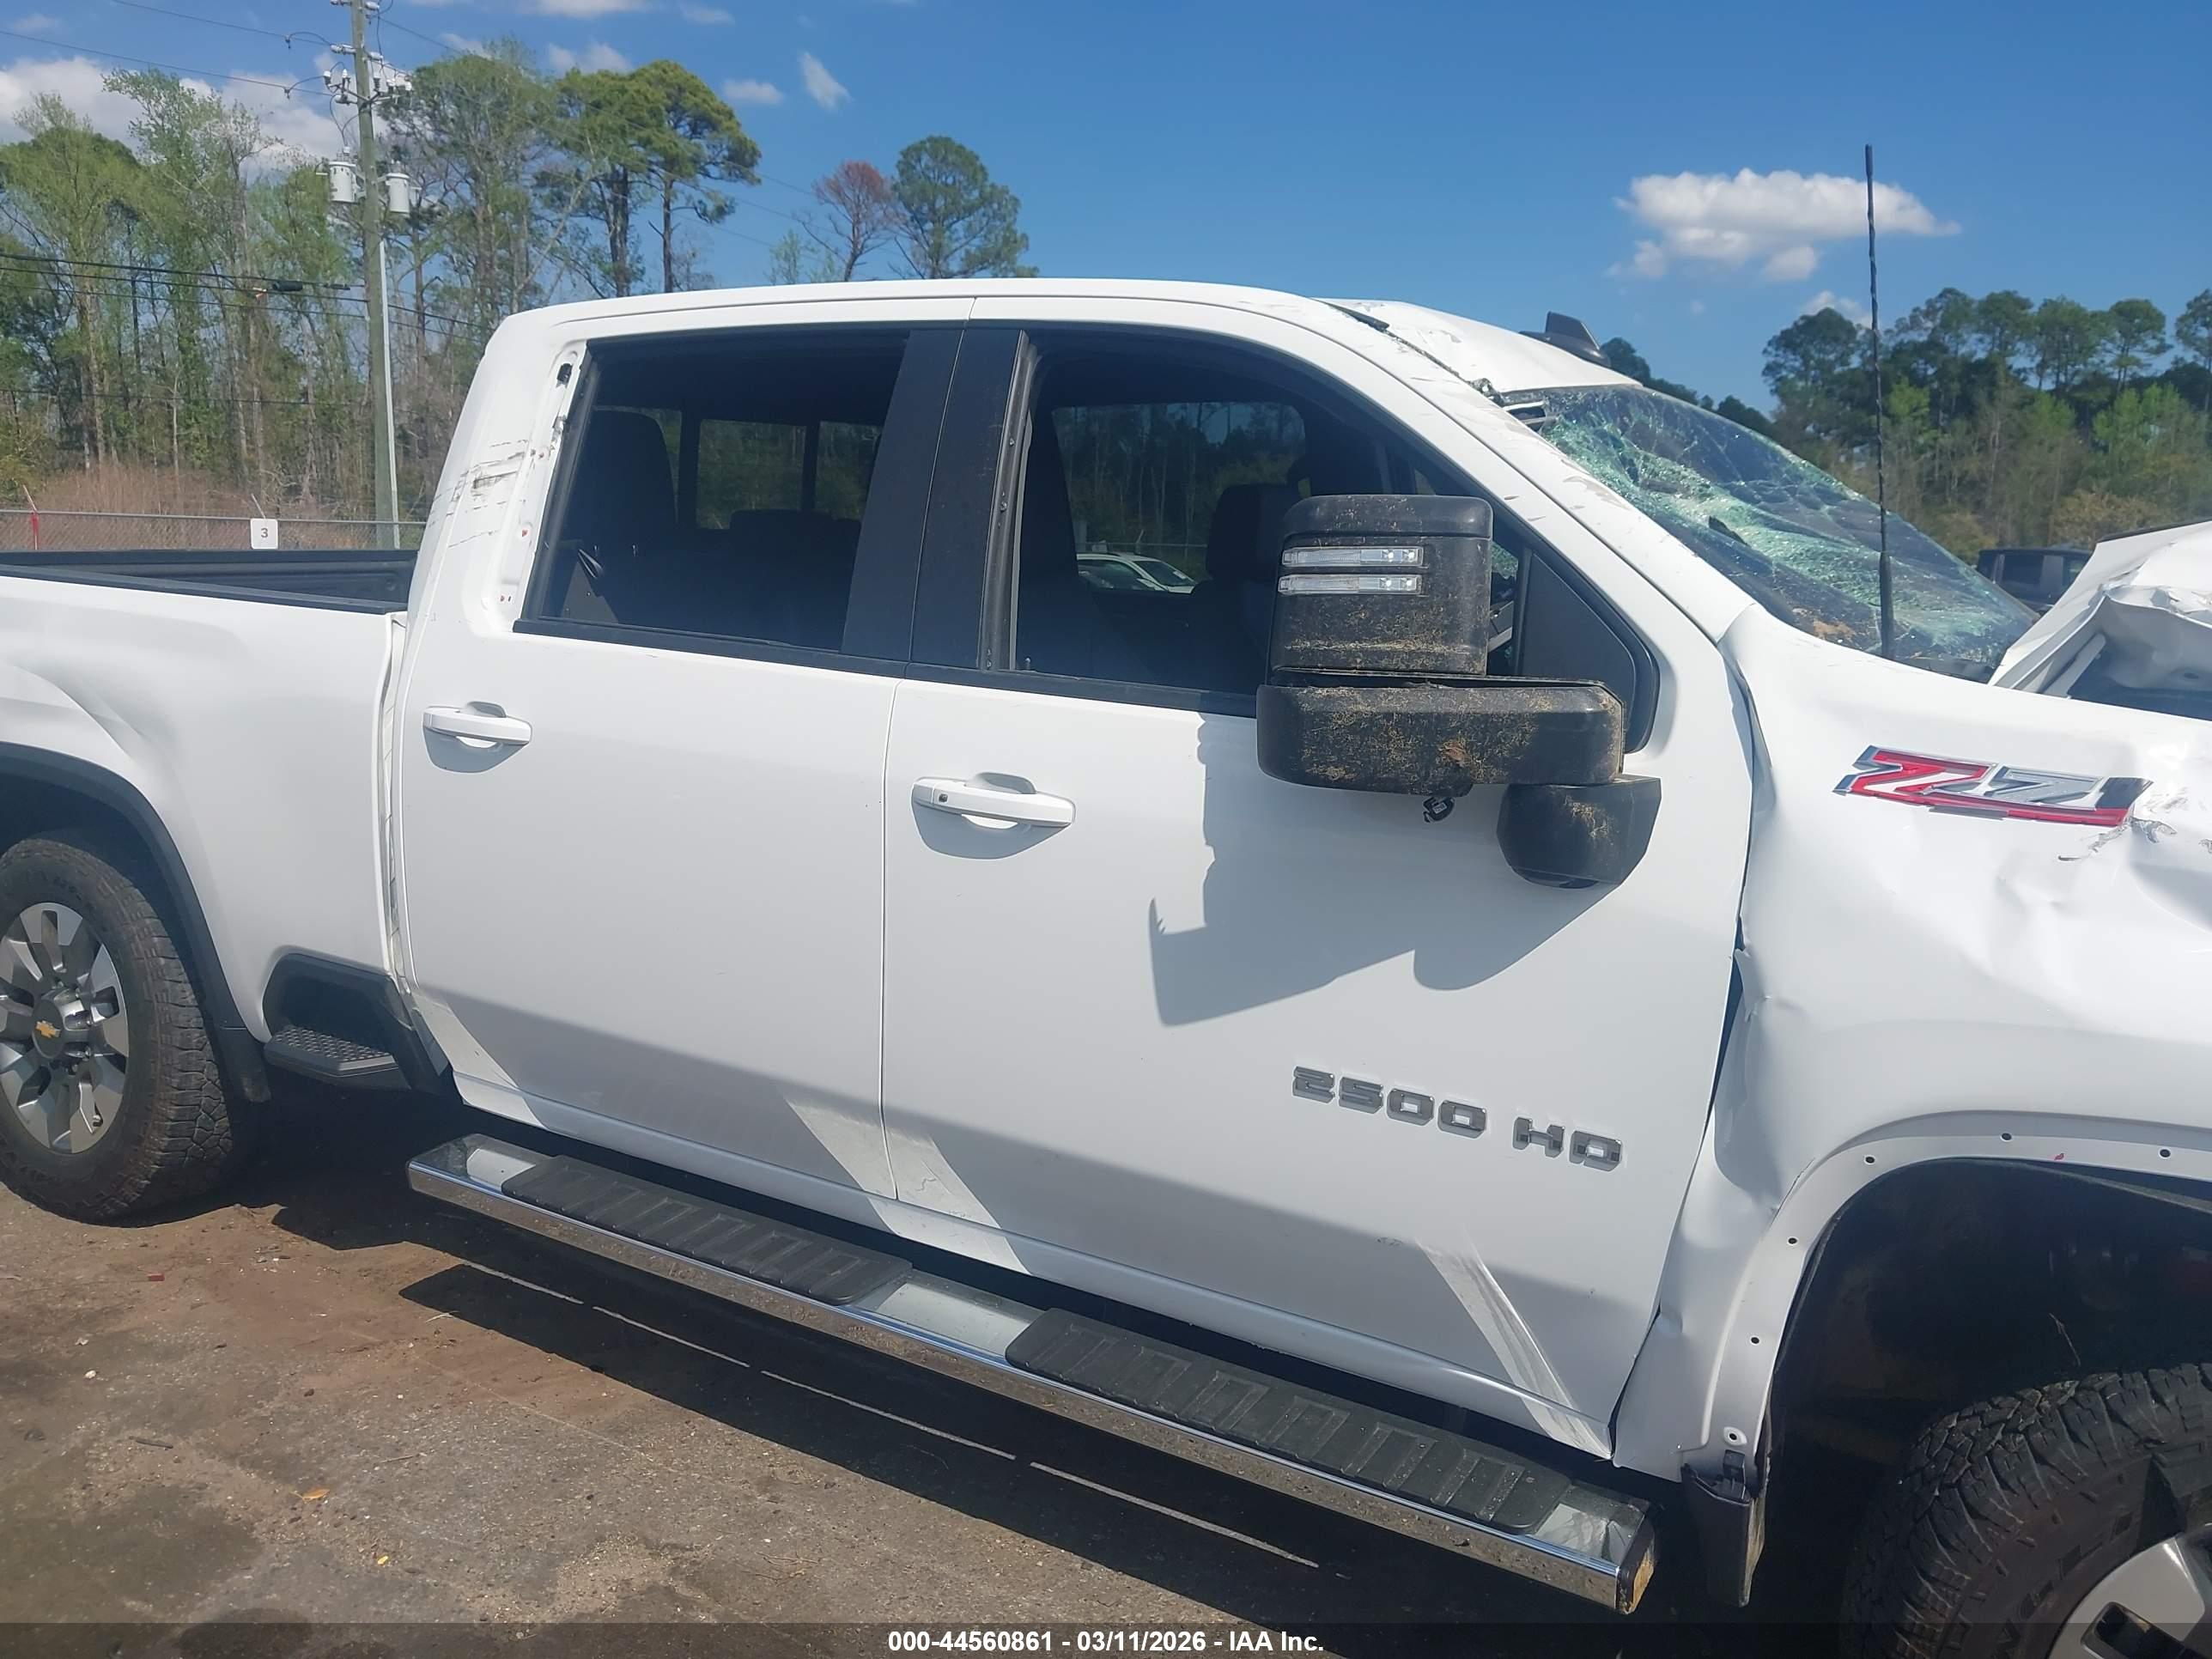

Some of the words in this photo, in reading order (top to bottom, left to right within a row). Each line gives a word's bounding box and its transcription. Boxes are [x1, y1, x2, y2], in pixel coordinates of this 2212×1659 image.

[260, 527, 269, 538] 3
[1292, 1066, 1487, 1139] 2500
[1512, 1116, 1623, 1172] HD
